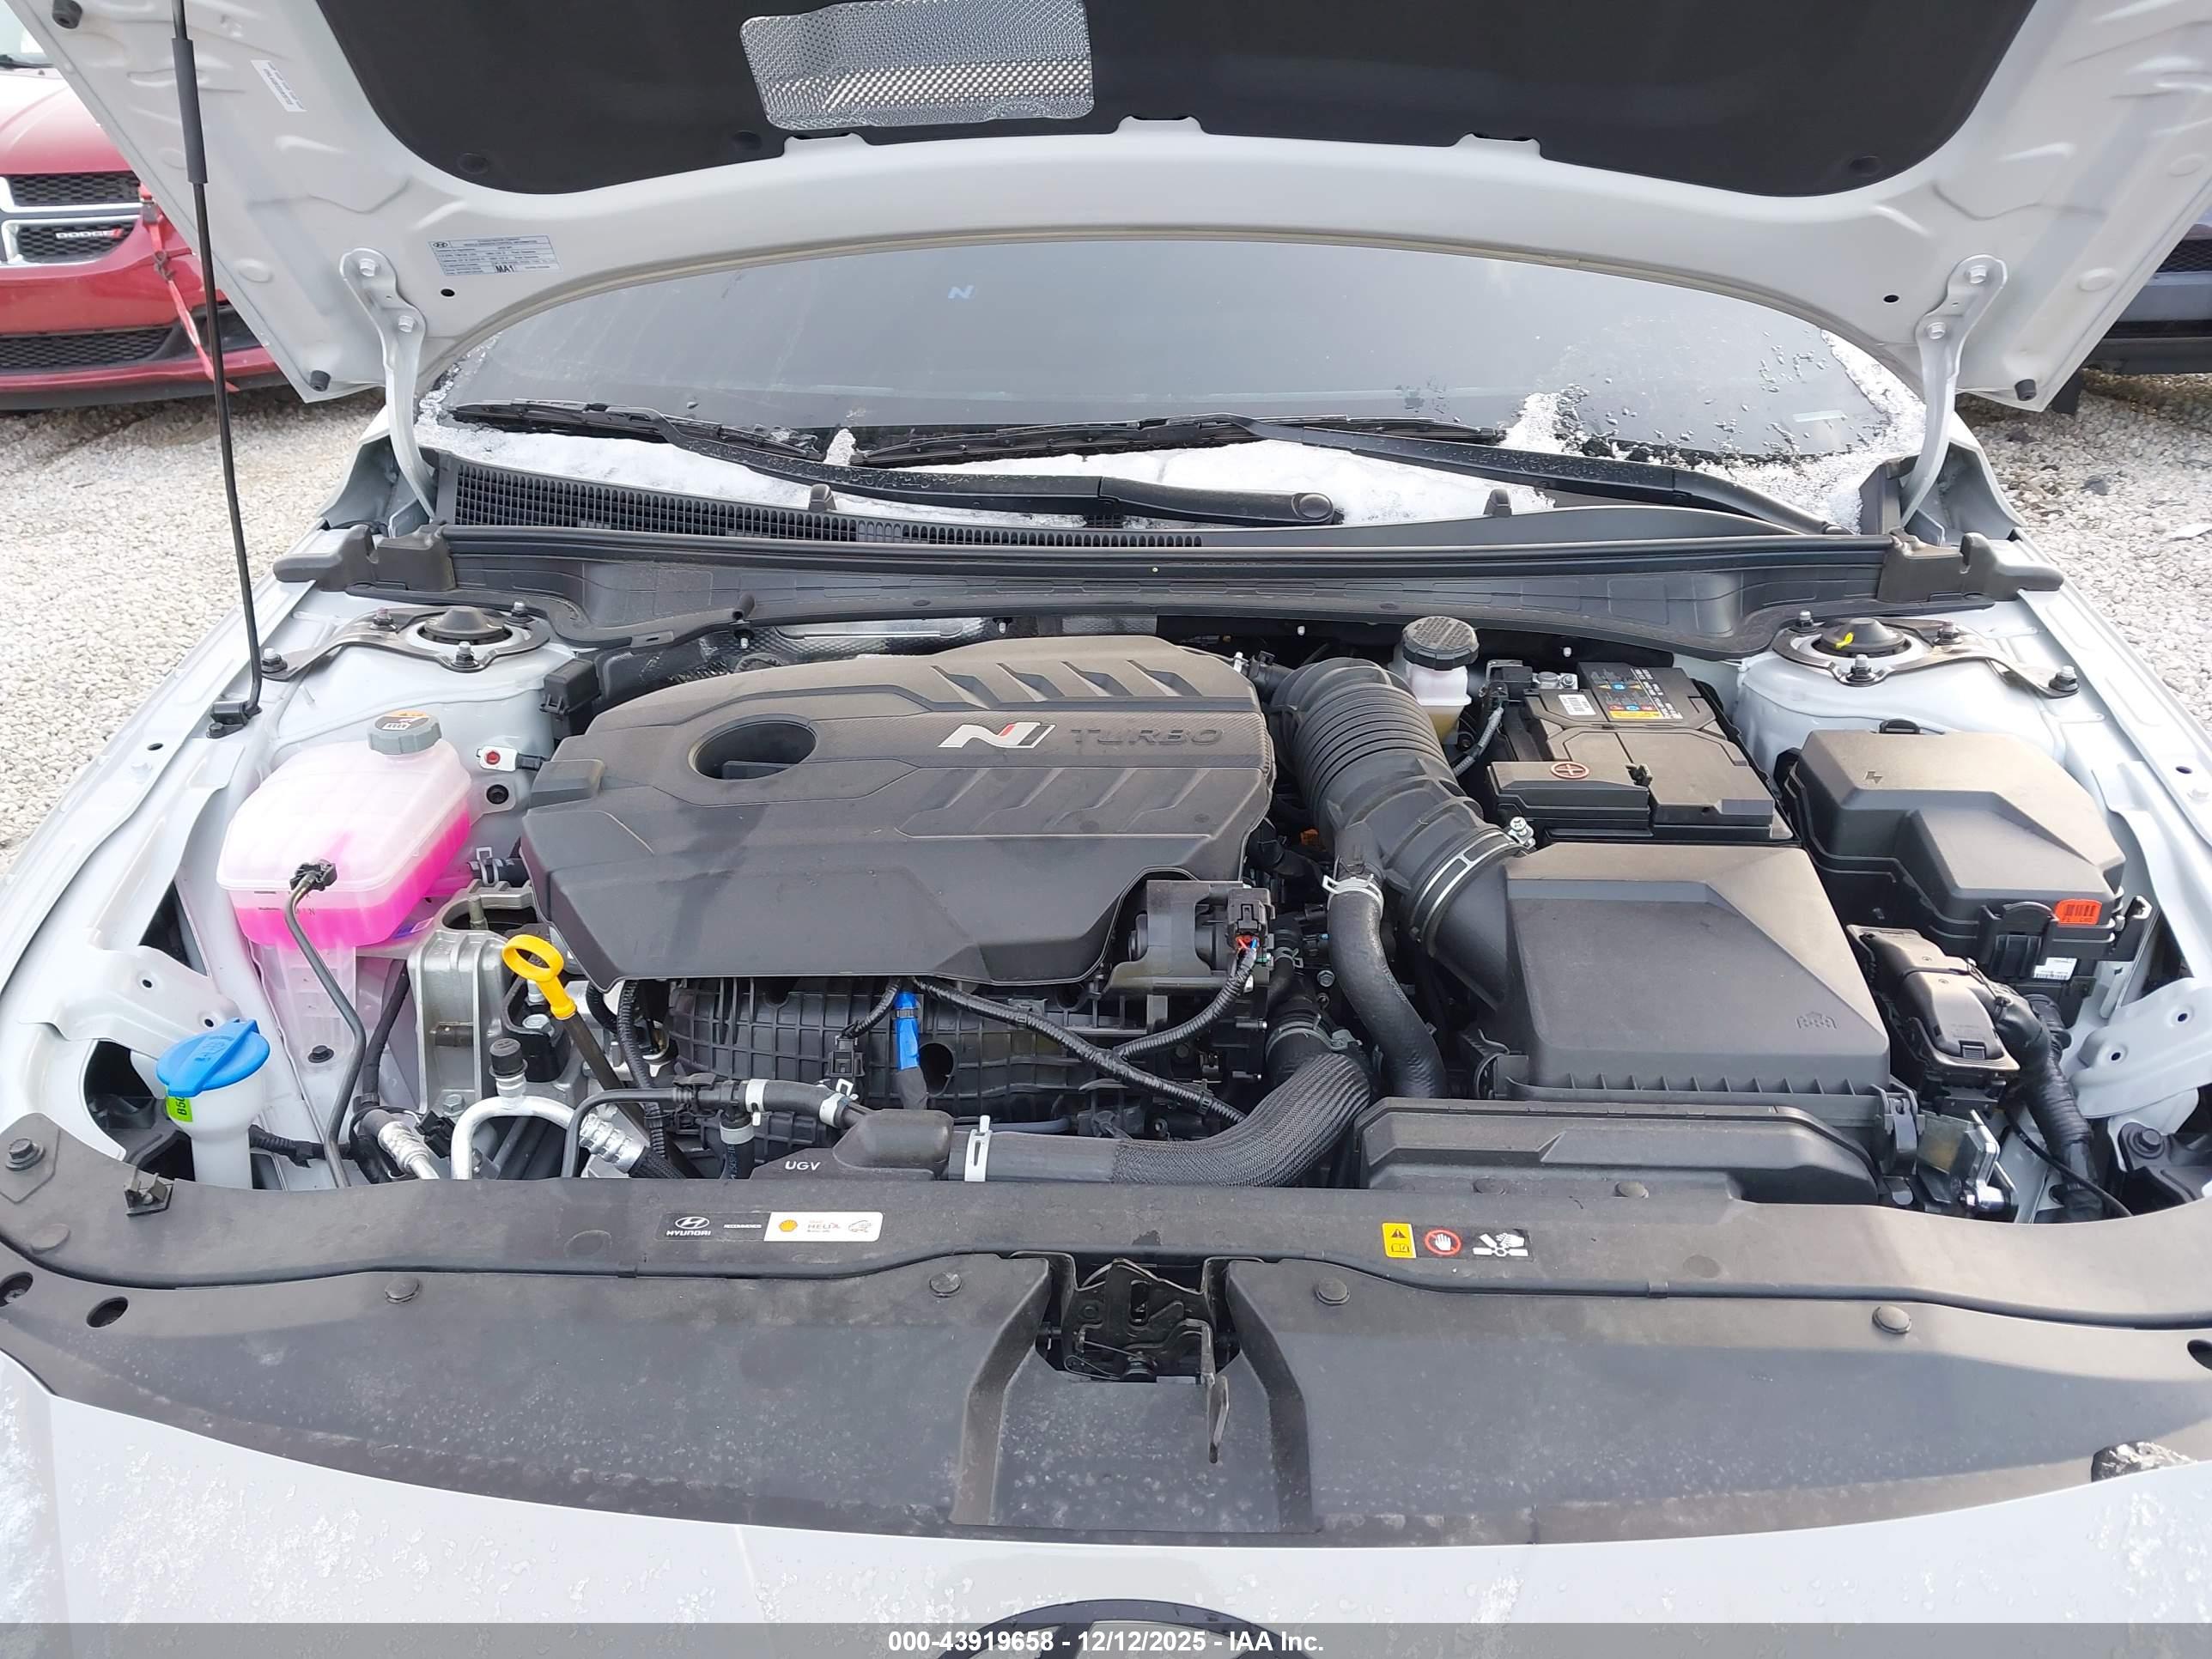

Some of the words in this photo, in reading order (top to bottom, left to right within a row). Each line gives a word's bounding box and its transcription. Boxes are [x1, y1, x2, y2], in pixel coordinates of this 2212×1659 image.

[55, 230, 113, 240] DODGE
[495, 264, 514, 273] MA1
[1070, 728, 1224, 745] TURBO
[785, 1160, 821, 1170] UGV
